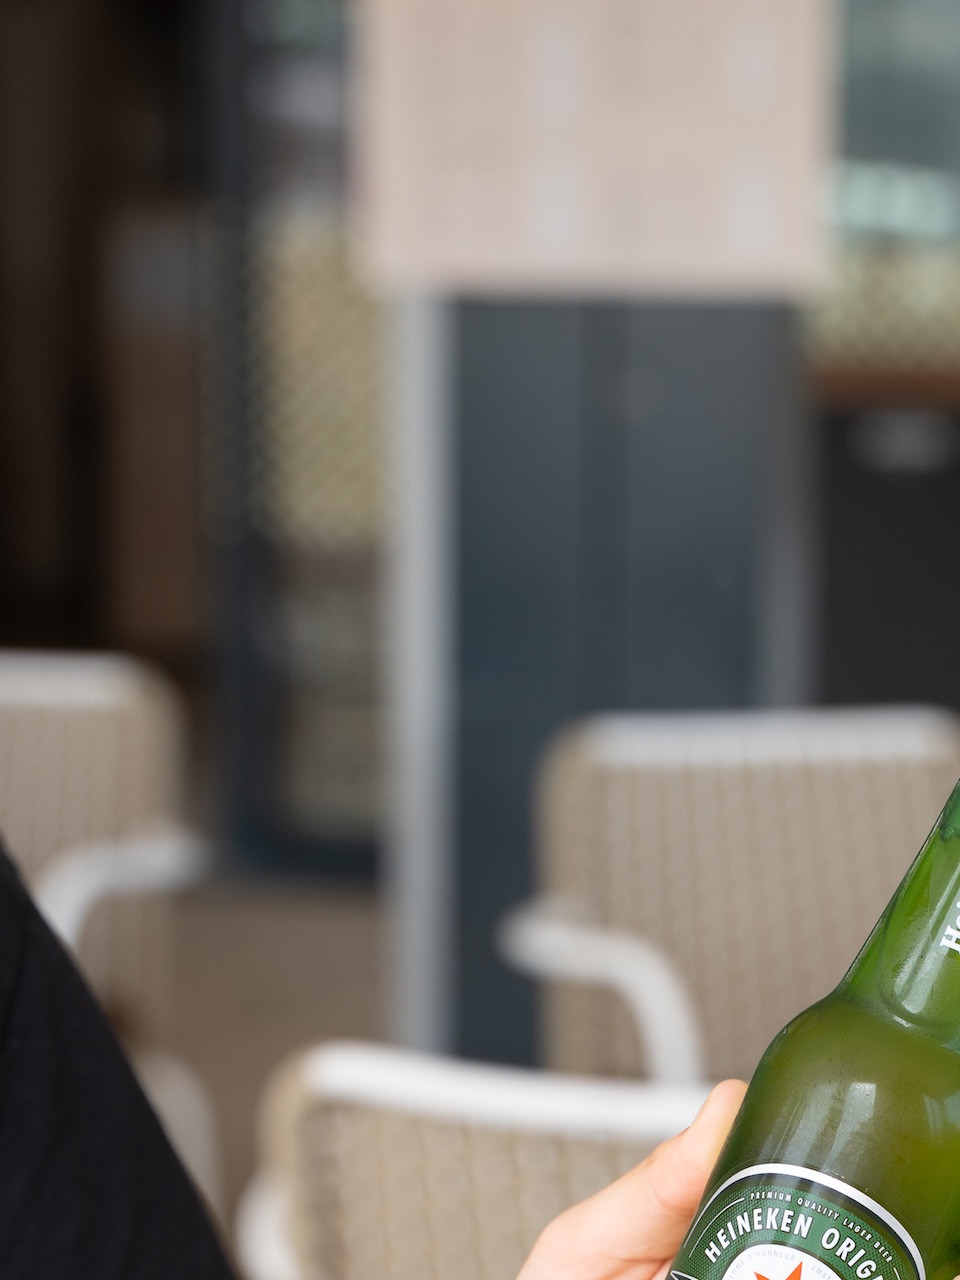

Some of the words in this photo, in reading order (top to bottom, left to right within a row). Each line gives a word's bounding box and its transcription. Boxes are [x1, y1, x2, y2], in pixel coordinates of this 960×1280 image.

[704, 1207, 813, 1263] HEINEKEN
[751, 1191, 792, 1202] PREMIUM
[797, 1197, 840, 1220] QUALITY
[843, 1218, 872, 1241] LAGER
[873, 1240, 893, 1263] BEER
